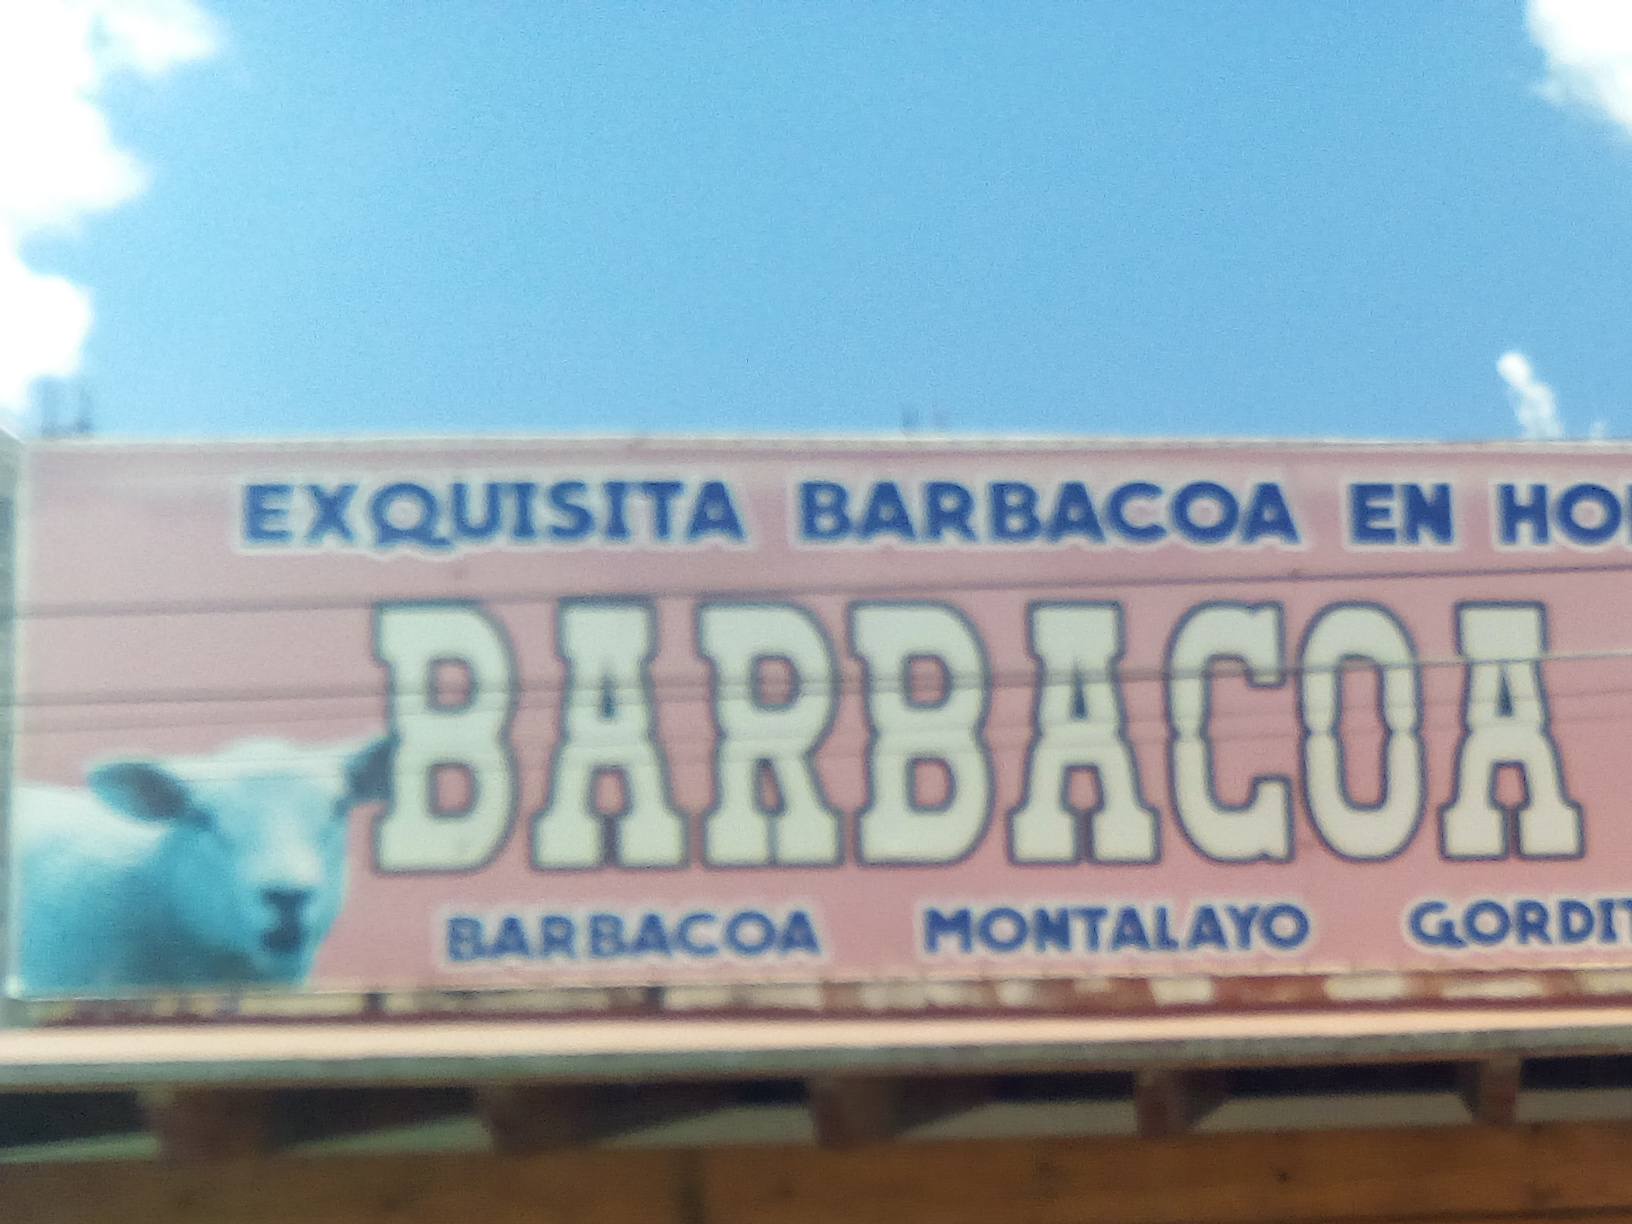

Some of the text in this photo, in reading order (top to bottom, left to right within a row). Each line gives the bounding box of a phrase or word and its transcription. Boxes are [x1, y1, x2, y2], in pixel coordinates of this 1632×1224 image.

[241, 480, 747, 549] EXQUISITA
[800, 480, 1300, 546] BARBACOA
[1350, 481, 1455, 547] EN
[371, 597, 1586, 875] BARBACOA
[445, 908, 824, 962] BARBACOA
[921, 902, 1313, 955] MONTALAYO
